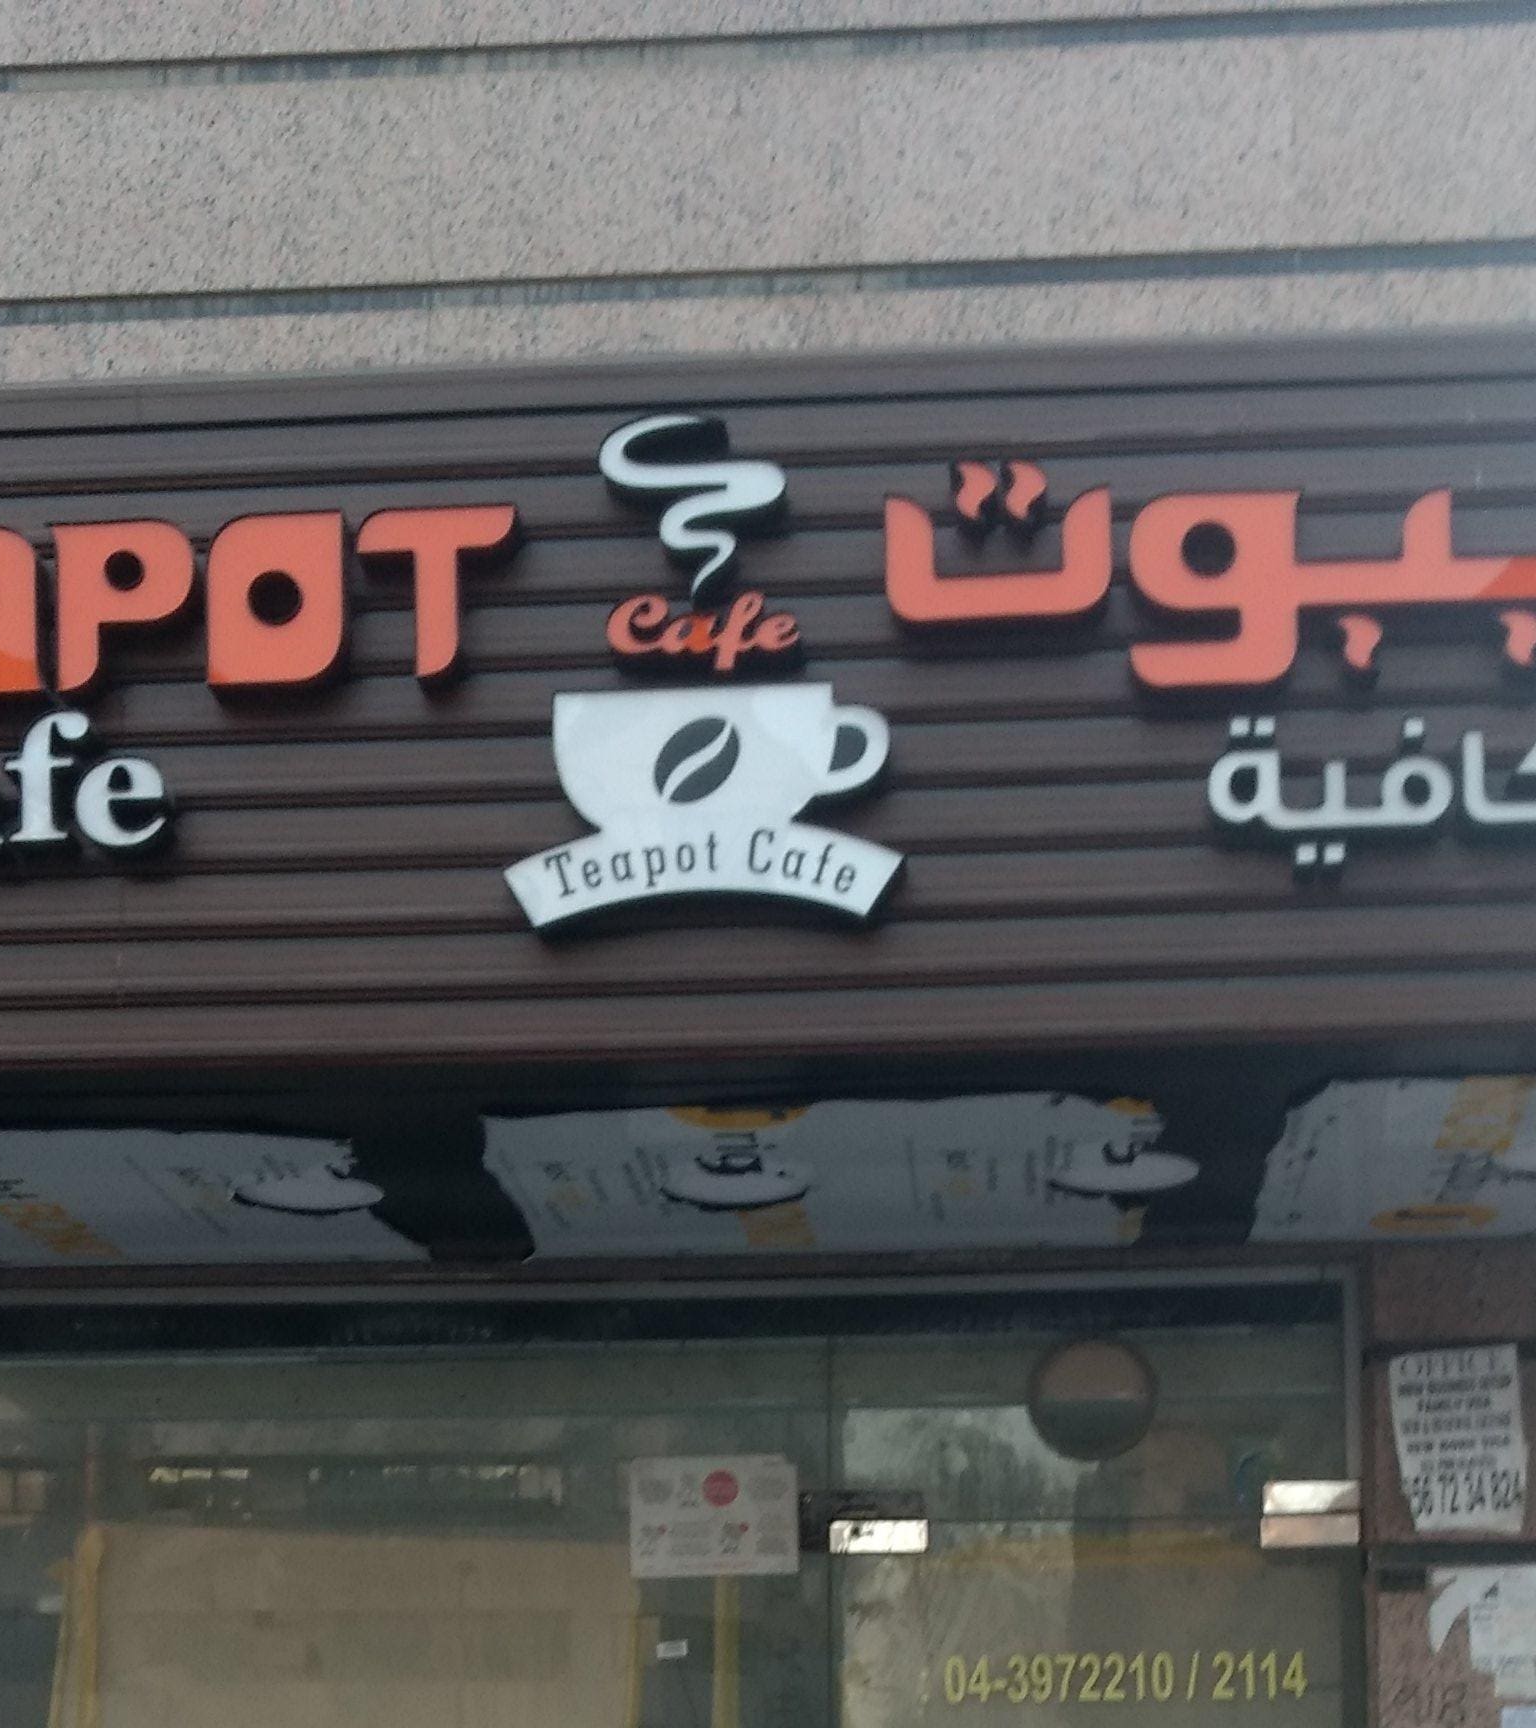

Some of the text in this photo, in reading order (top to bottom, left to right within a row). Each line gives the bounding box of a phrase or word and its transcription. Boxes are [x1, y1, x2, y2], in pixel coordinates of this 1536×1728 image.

[606, 590, 801, 670] Cafe
[544, 826, 858, 899] Teapot Cafe
[943, 1652, 1176, 1704] 04-3972210
[1212, 1650, 1308, 1701] 2114
